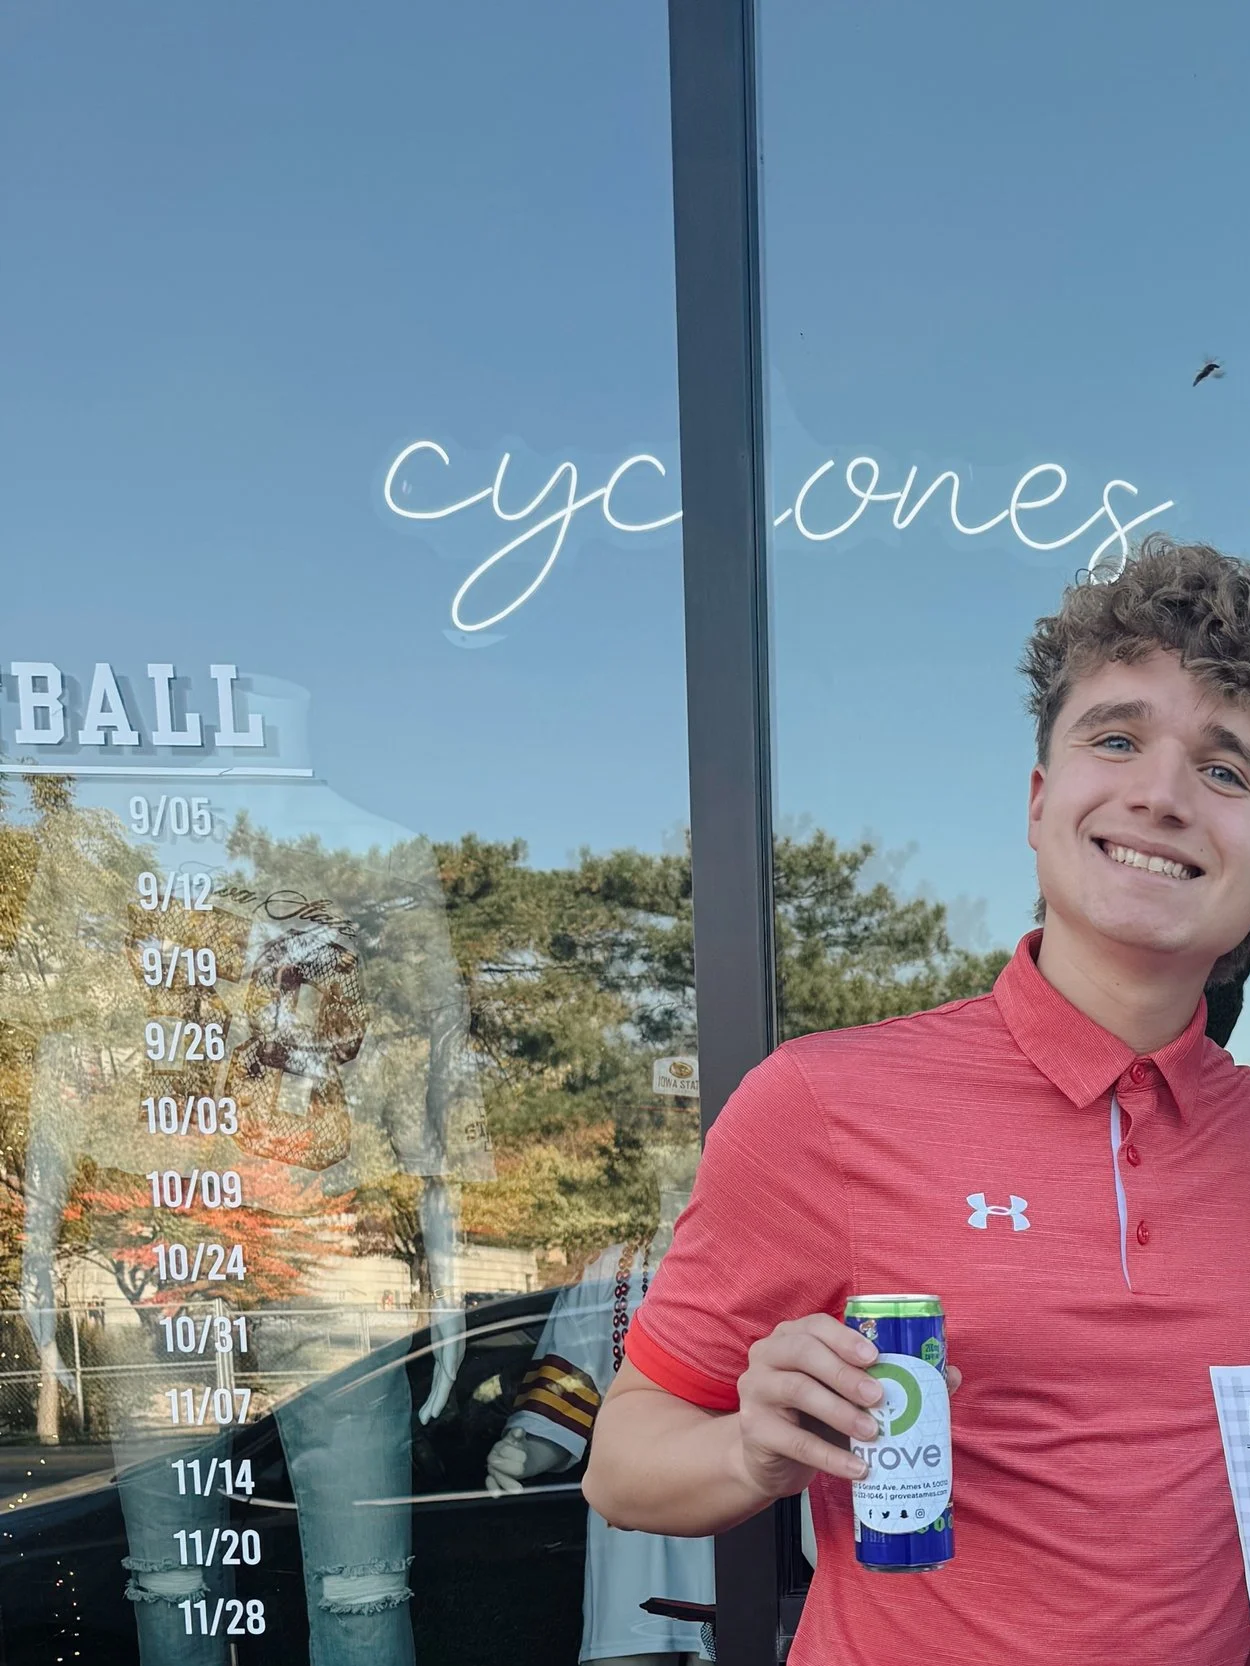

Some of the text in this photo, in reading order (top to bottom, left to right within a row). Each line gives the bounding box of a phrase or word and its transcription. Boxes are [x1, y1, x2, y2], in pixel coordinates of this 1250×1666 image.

[384, 440, 1173, 632] cycones
[10, 662, 266, 748] BALL
[129, 795, 212, 837] 9/05
[138, 871, 214, 912] 9/12
[141, 947, 217, 988] 9/19
[144, 1022, 226, 1063] 9/26
[141, 1095, 239, 1137] 10/03
[146, 1169, 242, 1209] 10/09
[152, 1243, 248, 1282] 10/24
[159, 1315, 249, 1354] 10/31
[165, 1387, 253, 1426] 11/07
[171, 1458, 255, 1496] 11/14
[173, 1528, 262, 1567] 11/20
[178, 1598, 266, 1636] 11/28
